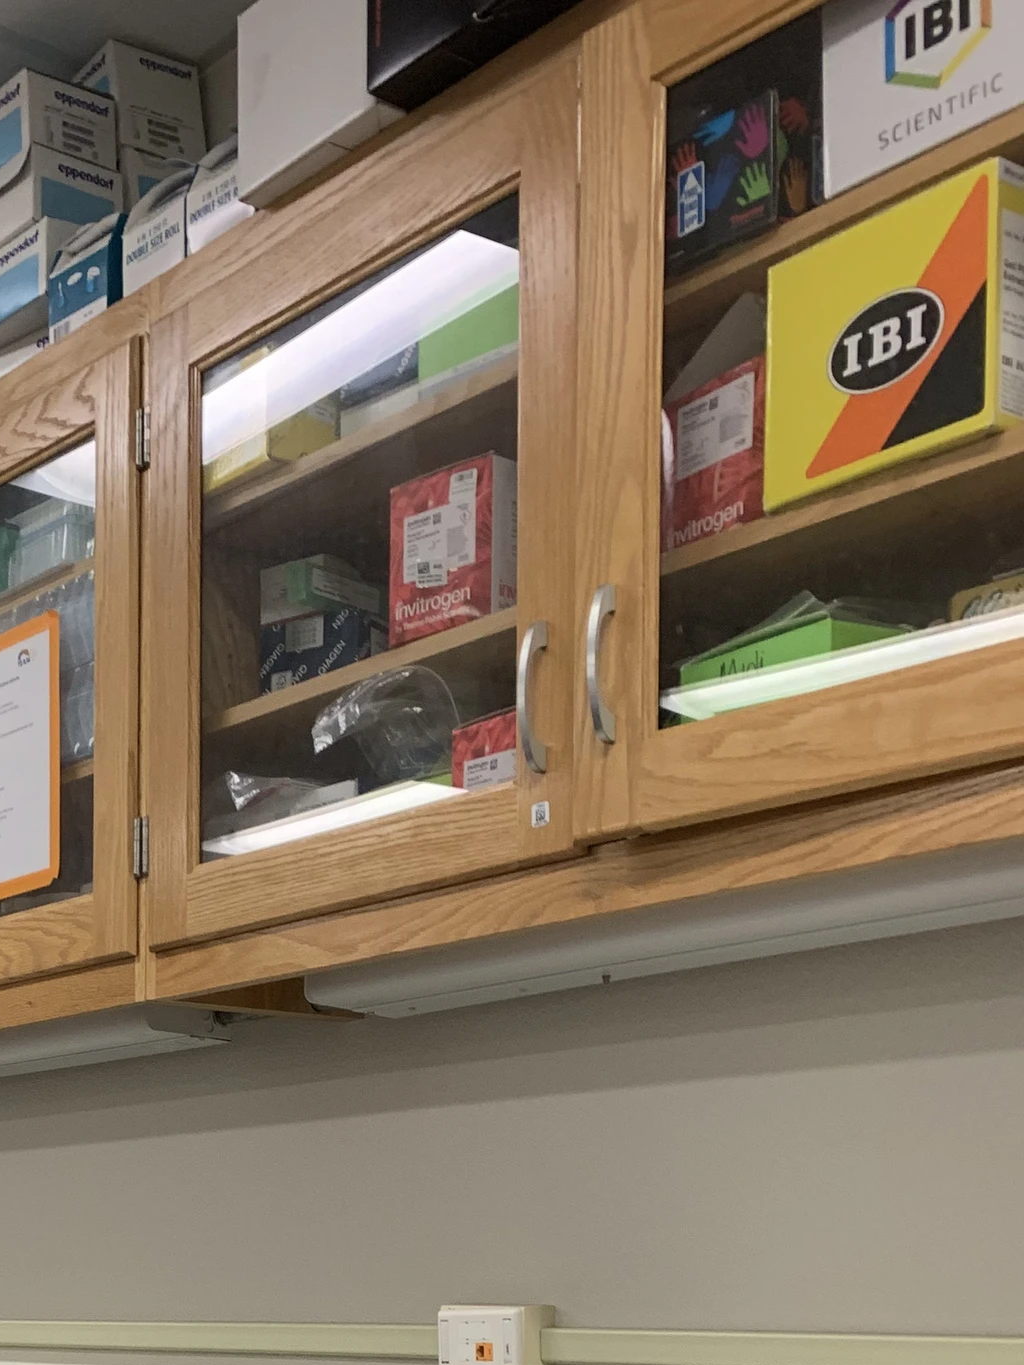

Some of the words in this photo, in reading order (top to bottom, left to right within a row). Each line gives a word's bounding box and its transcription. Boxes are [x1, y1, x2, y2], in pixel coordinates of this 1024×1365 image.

[904, 0, 970, 60] IBI
[139, 56, 192, 80] eppendorf
[54, 90, 109, 118] eppendorf
[878, 73, 1004, 151] SCIENTIFIC
[58, 162, 114, 190] eppendorf
[842, 304, 927, 378] IBI
[668, 500, 745, 548] invitrogen
[395, 586, 472, 621] invitrogen
[317, 639, 346, 676] QIAGEN
